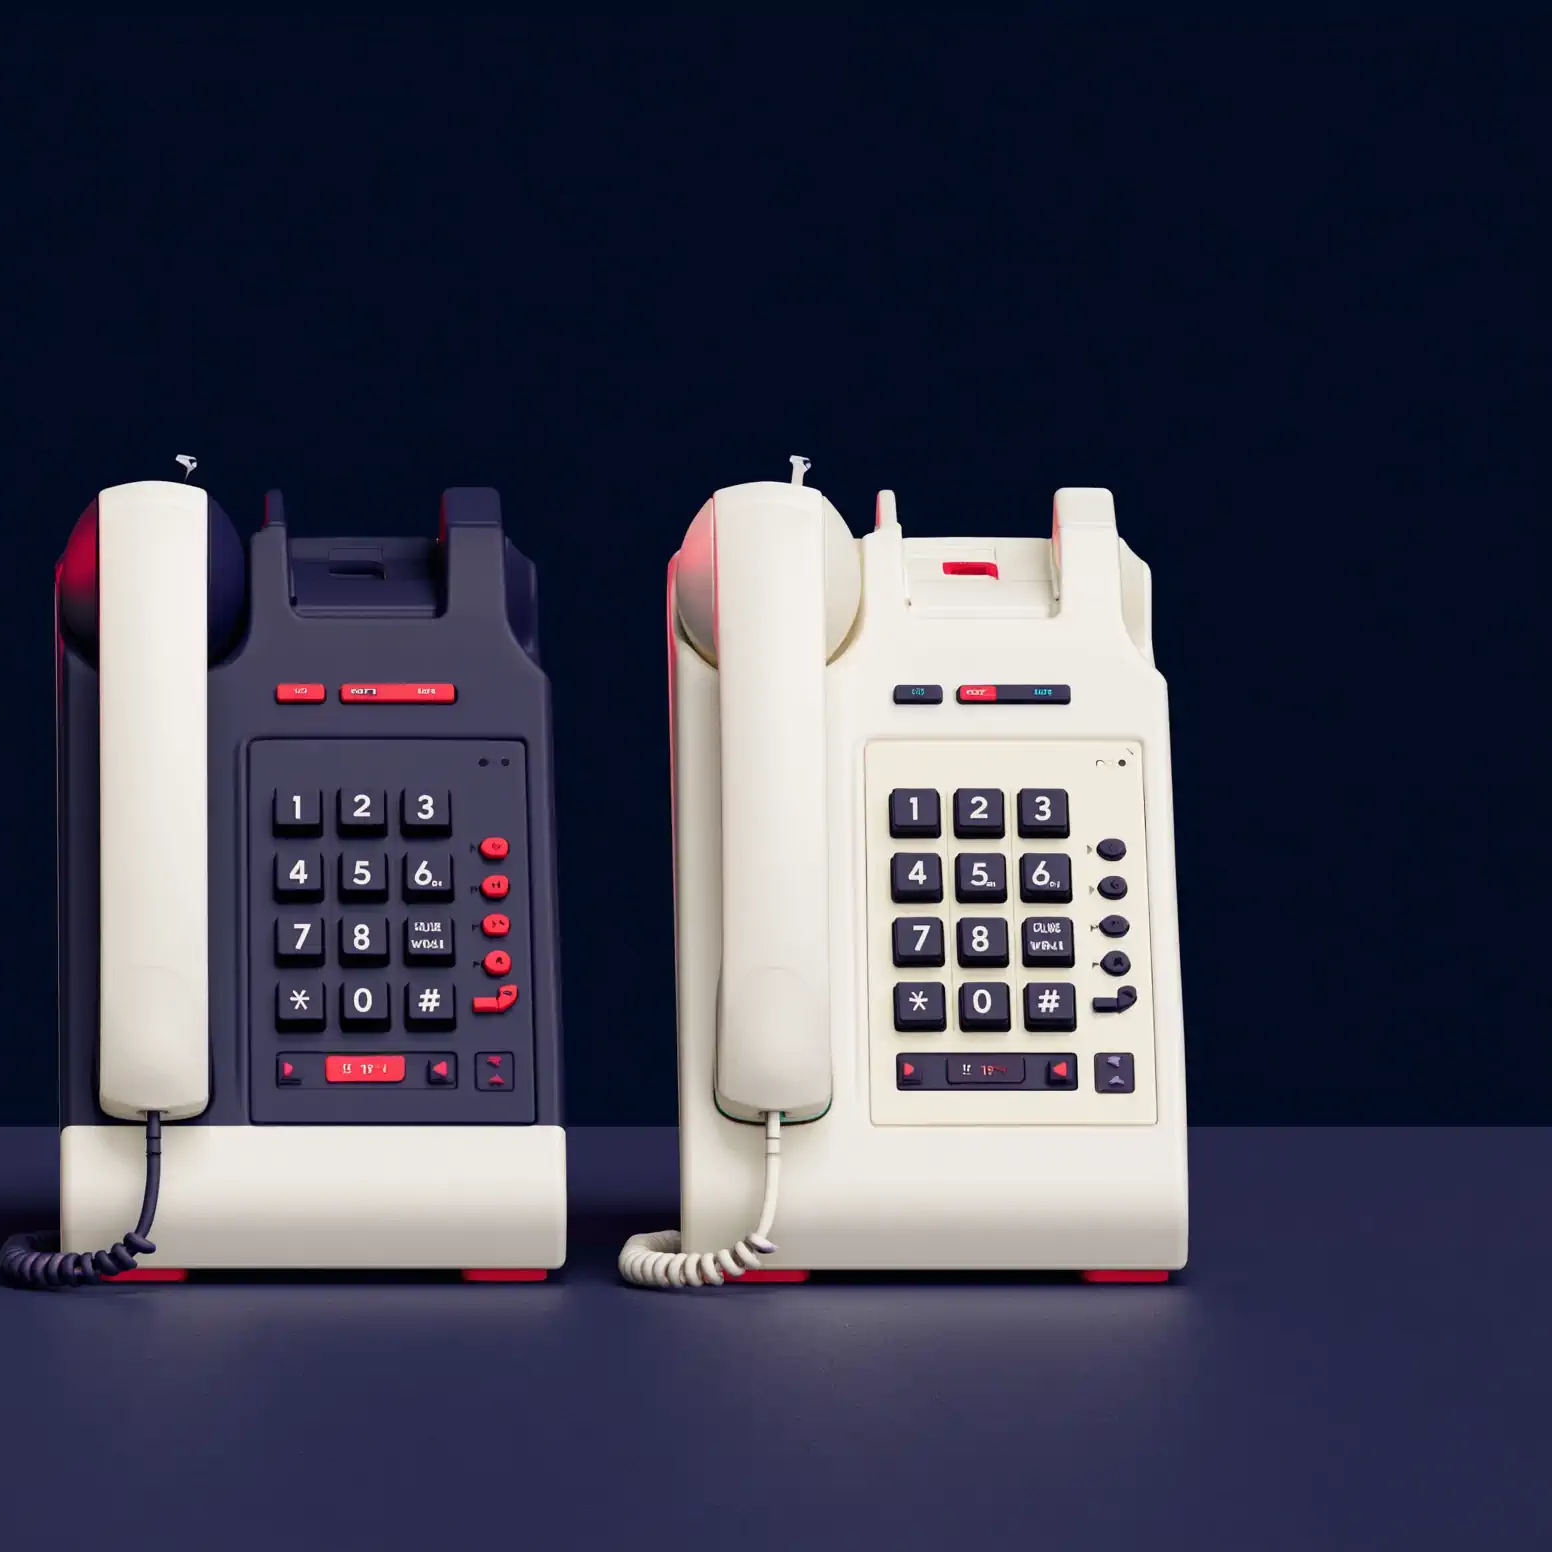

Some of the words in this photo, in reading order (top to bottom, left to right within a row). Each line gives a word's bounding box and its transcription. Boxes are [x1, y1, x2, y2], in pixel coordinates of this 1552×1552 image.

[292, 795, 301, 820] 1
[353, 794, 371, 817] 2
[417, 794, 434, 820] 3
[909, 796, 918, 821] 1
[970, 796, 988, 819] 2
[1034, 795, 1052, 821] 3
[289, 859, 308, 884] 4
[353, 860, 371, 885] 5
[414, 860, 433, 886] 6
[908, 860, 927, 885] 4
[970, 862, 988, 887] 5
[1032, 860, 1051, 886] 6
[293, 923, 311, 950] 7
[353, 923, 370, 951] 8
[913, 925, 931, 951] 7
[971, 925, 989, 952] 8
[353, 987, 373, 1013] 0
[418, 988, 441, 1012] #
[972, 989, 992, 1014] 0
[1037, 989, 1061, 1013] #
